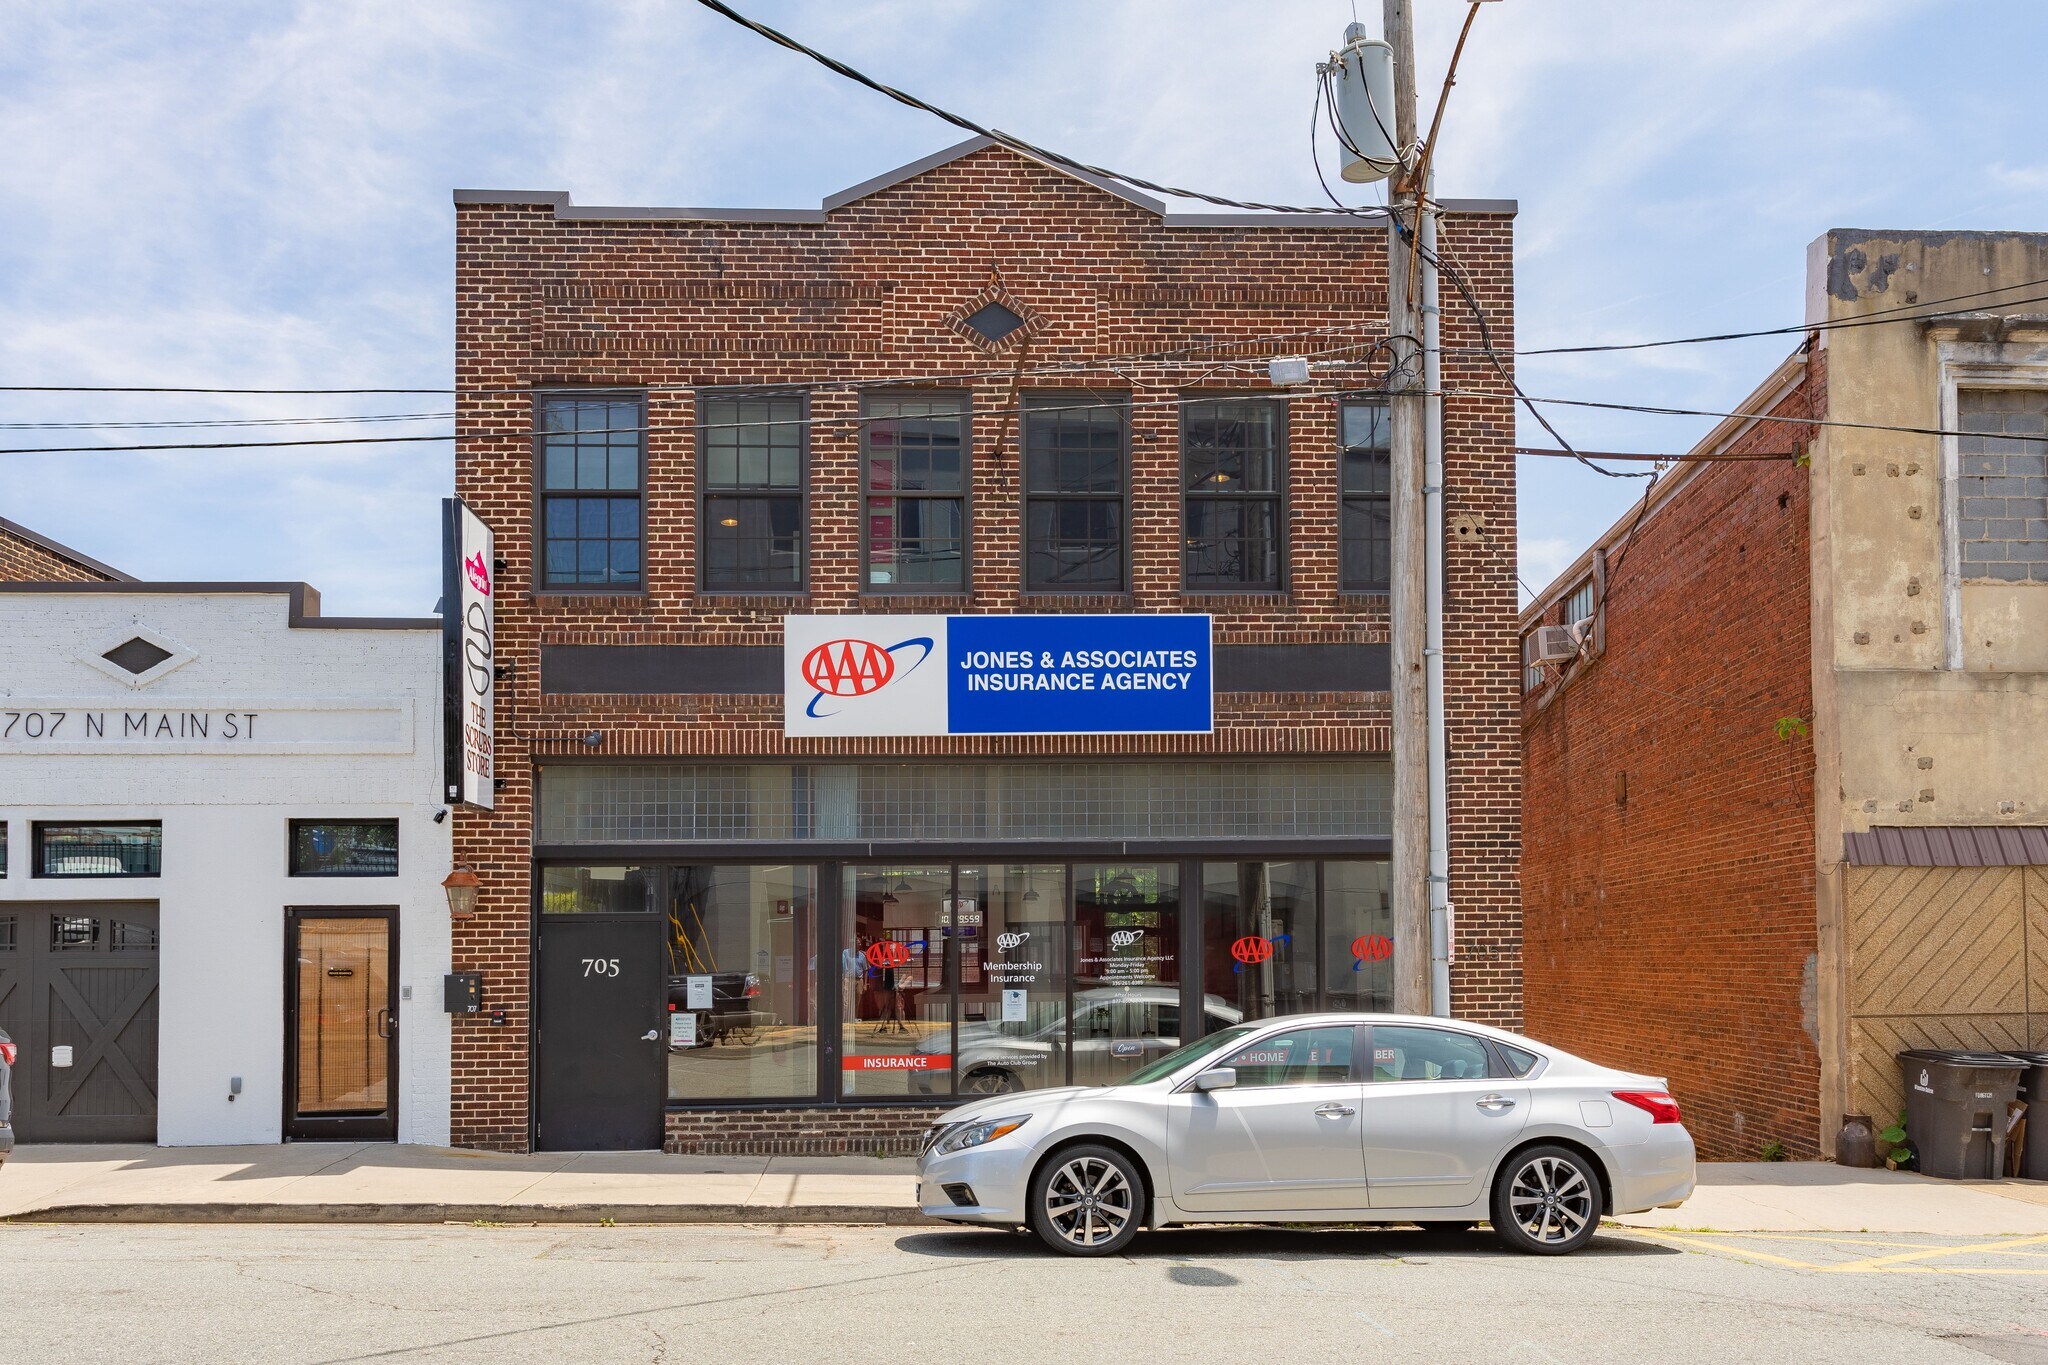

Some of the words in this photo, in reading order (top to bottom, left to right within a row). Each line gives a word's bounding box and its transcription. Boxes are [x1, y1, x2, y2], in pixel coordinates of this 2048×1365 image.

[802, 639, 894, 696] AAA
[960, 651, 1033, 670] JONES
[1040, 650, 1055, 669] &
[1061, 650, 1198, 669] ASSOCIATES
[967, 673, 1096, 692] INSURANCE
[1100, 672, 1191, 690] AGENCY
[470, 701, 486, 729] THE
[4, 712, 66, 738] 707
[86, 712, 104, 738] N
[124, 712, 208, 738] MAIN
[222, 713, 258, 739] ST
[465, 724, 492, 756] SCRUBS
[466, 749, 490, 779] STORE
[997, 932, 1020, 948] AAA
[1111, 930, 1134, 946] AAA
[1350, 934, 1393, 962] AAA
[866, 940, 910, 968] AAA
[1231, 936, 1274, 964] AAA
[581, 958, 620, 978] 705
[983, 961, 1042, 972] Membership
[990, 974, 1036, 982] Insurance
[1118, 1044, 1136, 1053] Open
[1249, 1053, 1284, 1062] HOME
[863, 1058, 927, 1068] INSURANCE
